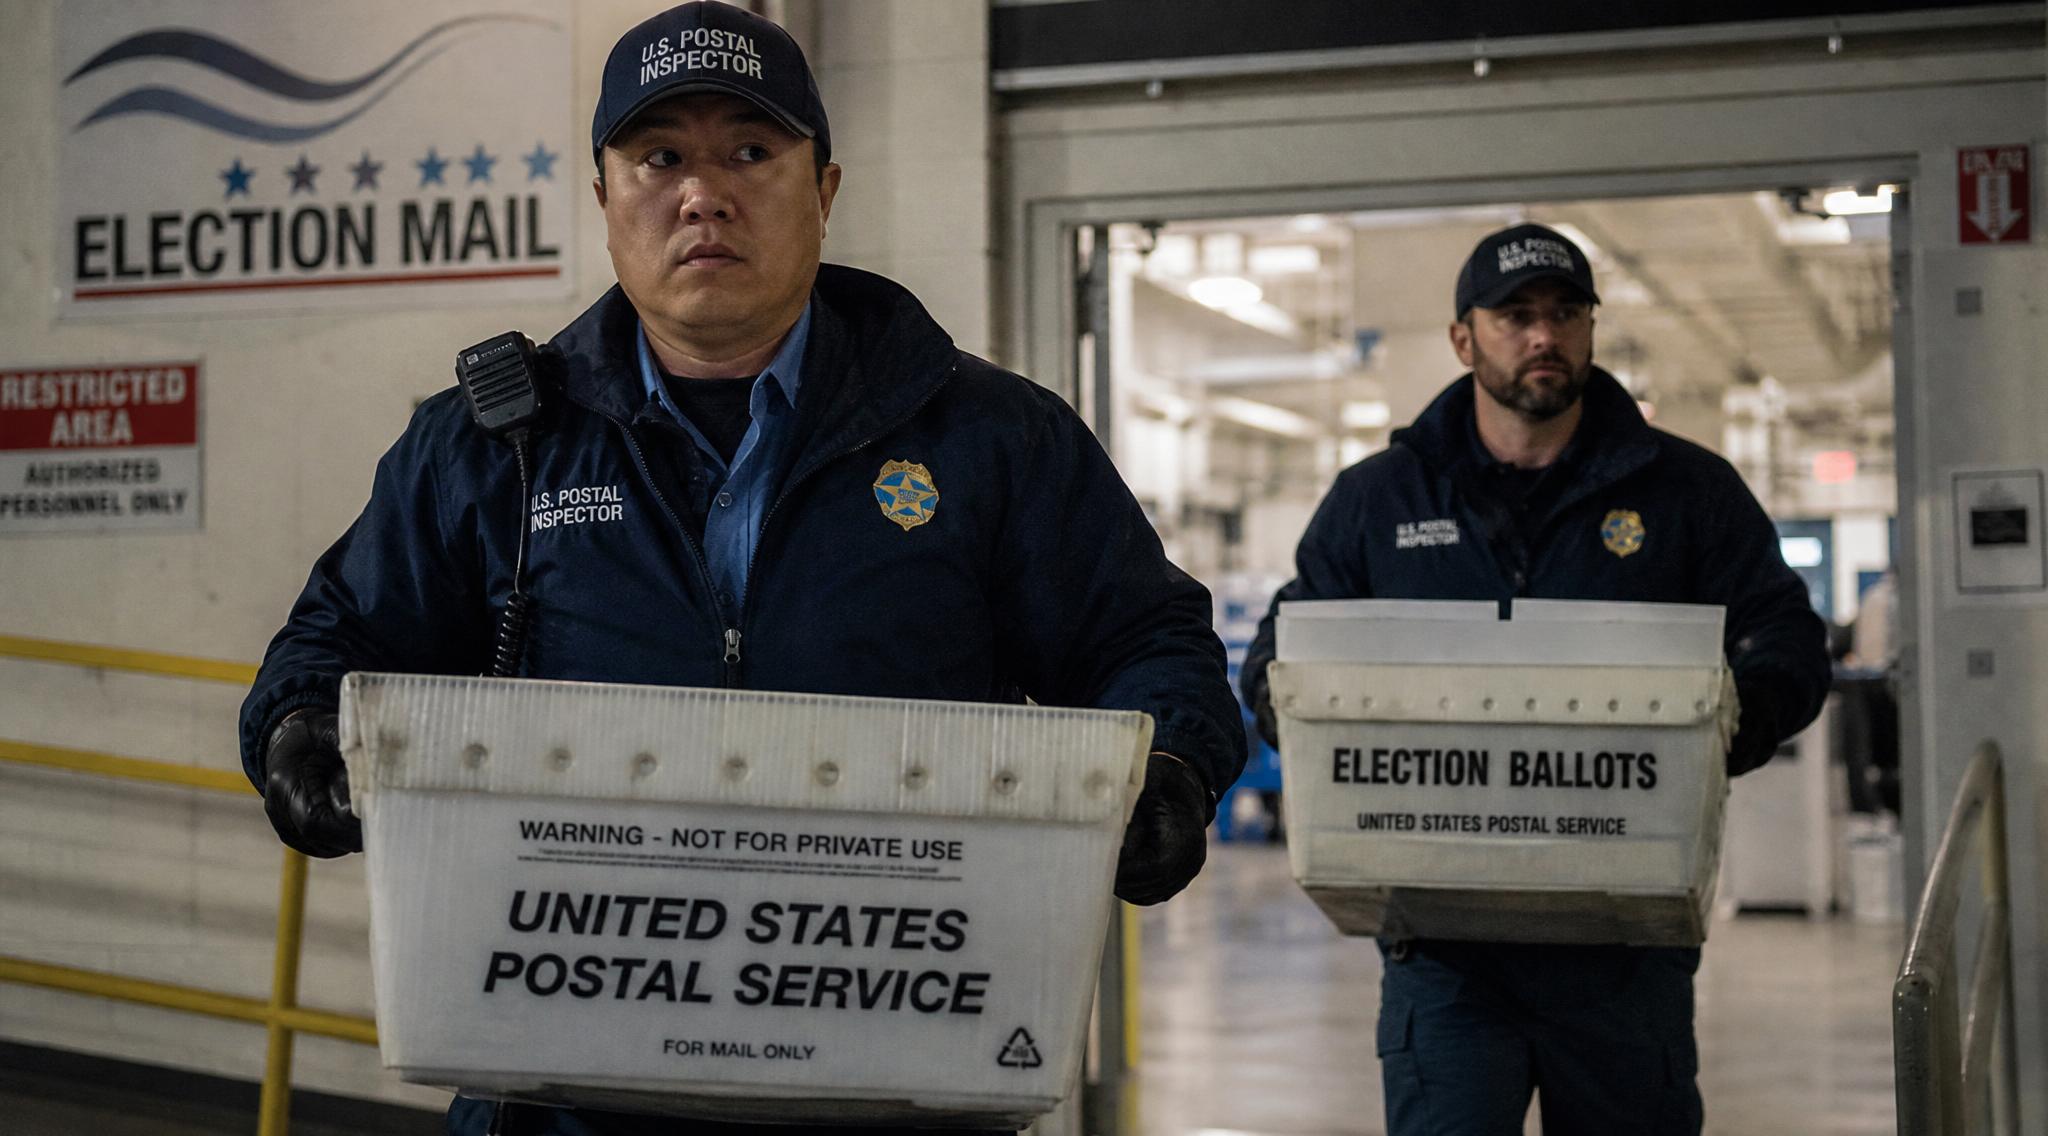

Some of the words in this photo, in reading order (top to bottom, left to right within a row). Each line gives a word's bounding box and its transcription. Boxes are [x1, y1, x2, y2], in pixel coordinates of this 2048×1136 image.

[641, 37, 674, 63] U.S.
[680, 28, 761, 58] POSTAL
[640, 50, 763, 86] INSPECTOR
[75, 204, 376, 280] ELECTION
[402, 195, 559, 265] MAIL
[1, 369, 186, 410] RESTRICTED
[51, 408, 133, 446] AREA
[24, 458, 161, 487] AUTHORIZED
[0, 492, 122, 518] PERSONNEL
[131, 488, 187, 516] ONLY
[531, 492, 554, 512] U.S.
[559, 485, 623, 506] POSTAL
[531, 504, 623, 533] INSPECTOR
[1333, 748, 1488, 786] ELECTION
[1509, 751, 1657, 790] BALLOTS
[519, 820, 644, 846] WARNING
[671, 829, 726, 850] NOT
[735, 831, 788, 853] FOR
[797, 834, 902, 858] PRIVATE
[911, 840, 963, 861] USE
[1357, 813, 1415, 831] UNITED
[1421, 814, 1482, 833] STATES
[1487, 815, 1550, 834] POSTAL
[1556, 817, 1626, 836] SERVICE
[508, 890, 728, 941] UNITED
[744, 901, 969, 953] STATES
[483, 952, 713, 1004] POSTAL
[733, 962, 991, 1015] SERVICE
[663, 1039, 704, 1057] FOR
[710, 1041, 758, 1059] MAIL
[763, 1043, 816, 1060] ONLY
